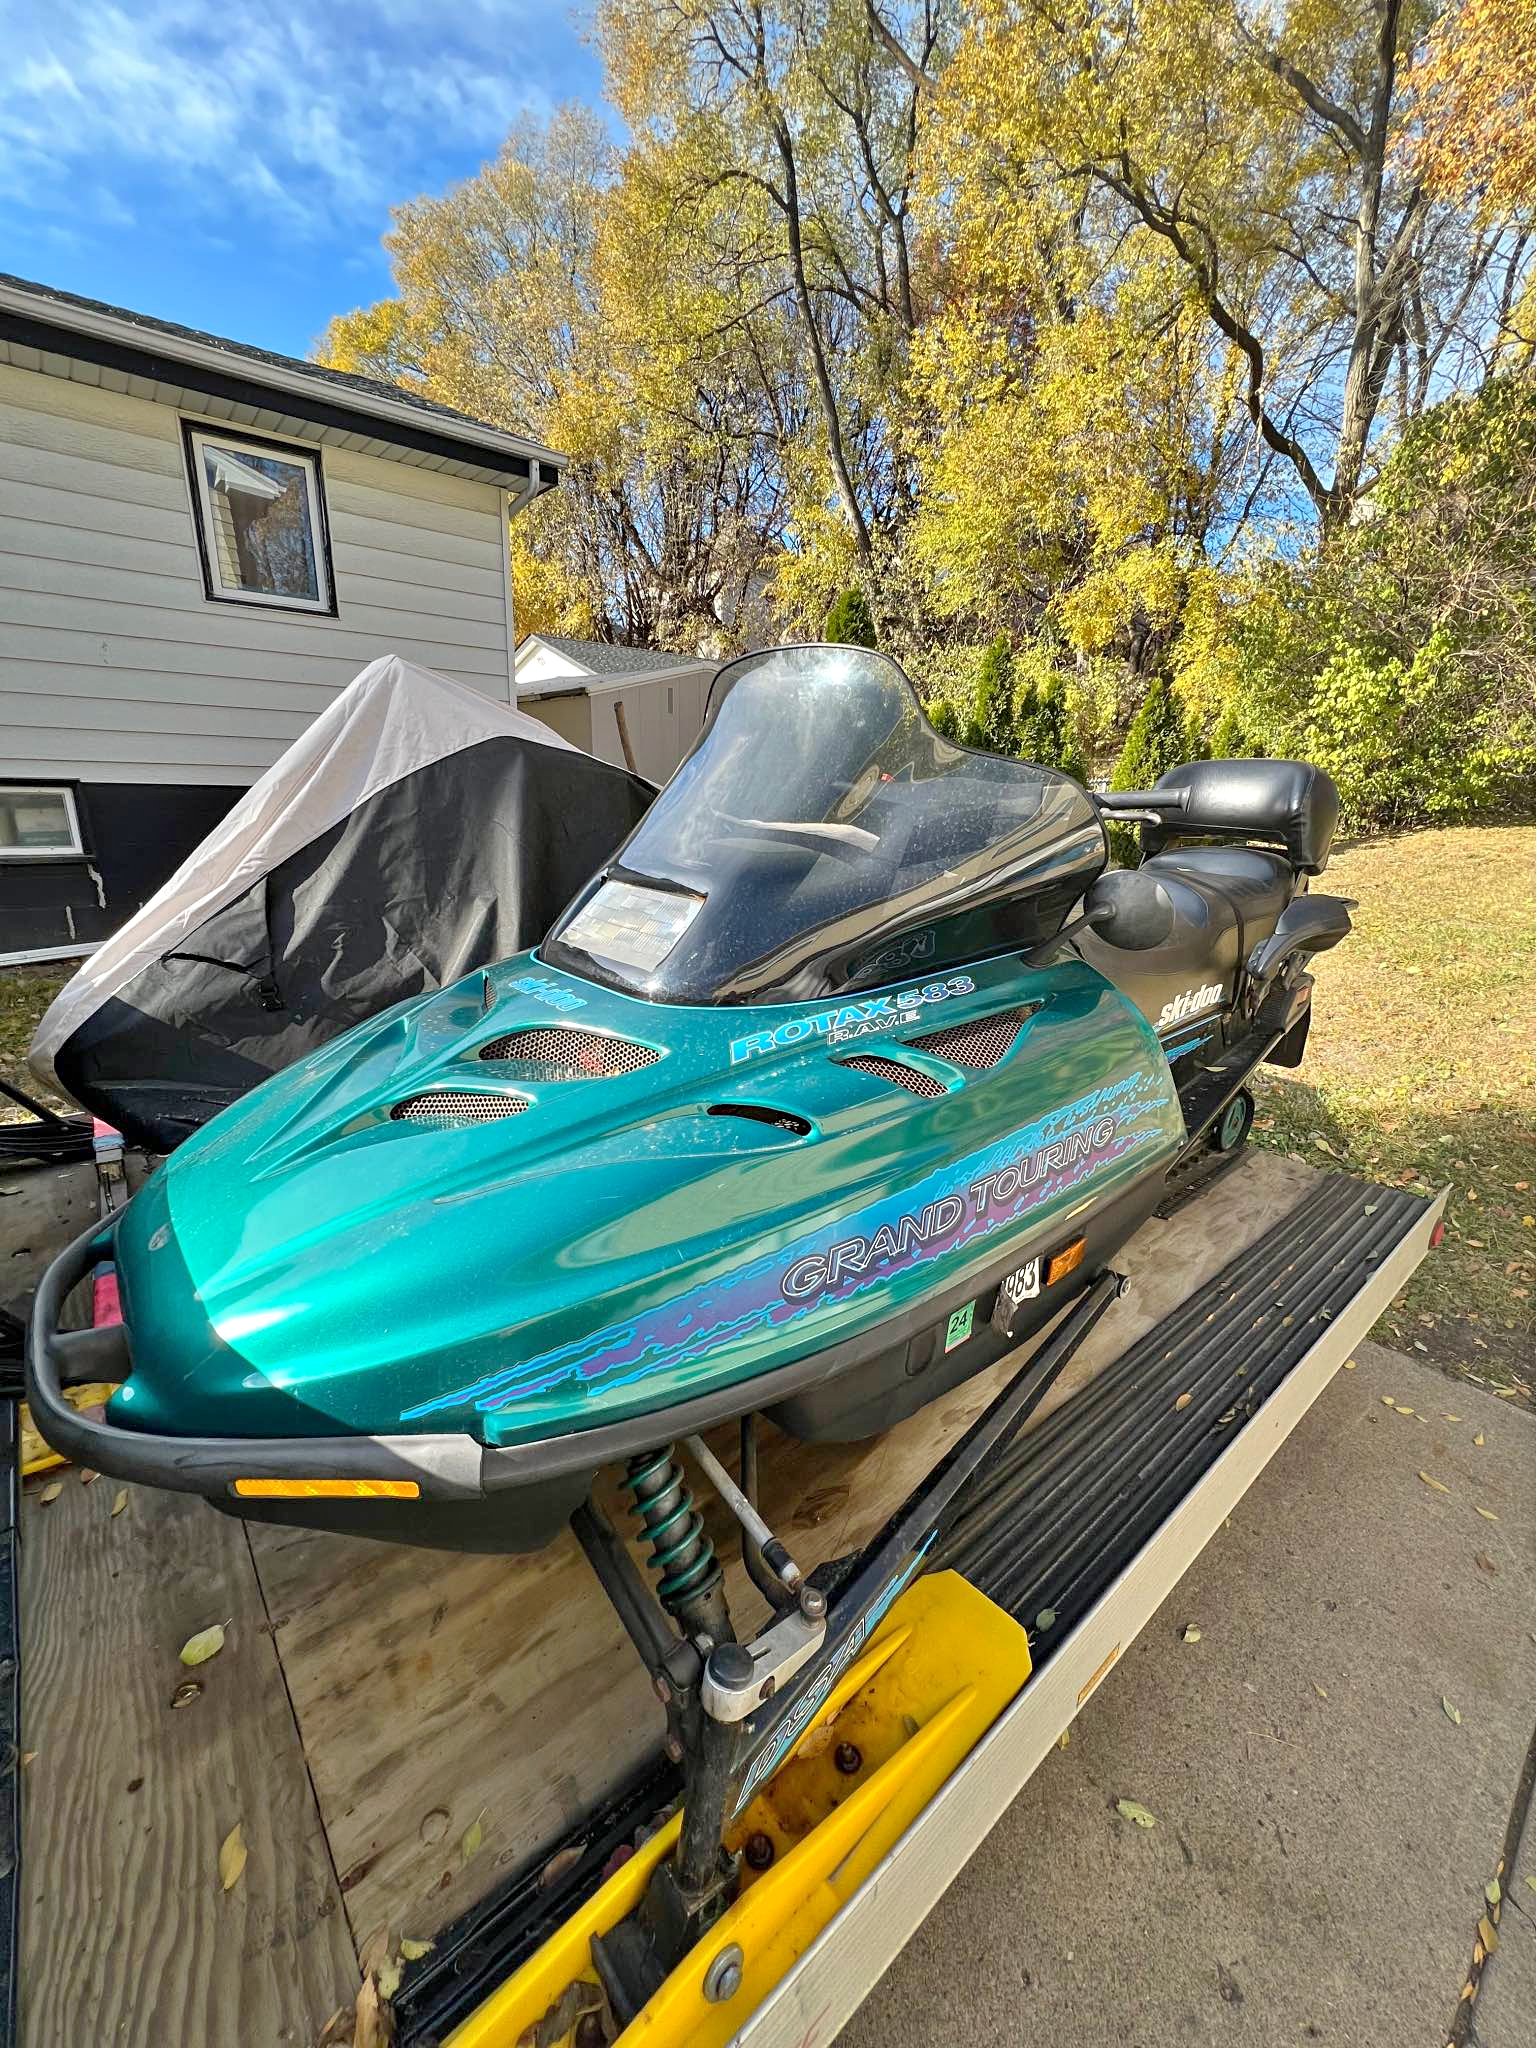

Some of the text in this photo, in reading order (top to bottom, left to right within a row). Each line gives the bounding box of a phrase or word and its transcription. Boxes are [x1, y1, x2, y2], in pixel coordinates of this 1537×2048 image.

[508, 976, 588, 1012] ski-doo
[1159, 983, 1223, 1027] ski-doo
[730, 975, 975, 1065] ROTAX 583
[780, 1117, 1115, 1299] GRAND TOURING
[950, 1310, 968, 1335] 24
